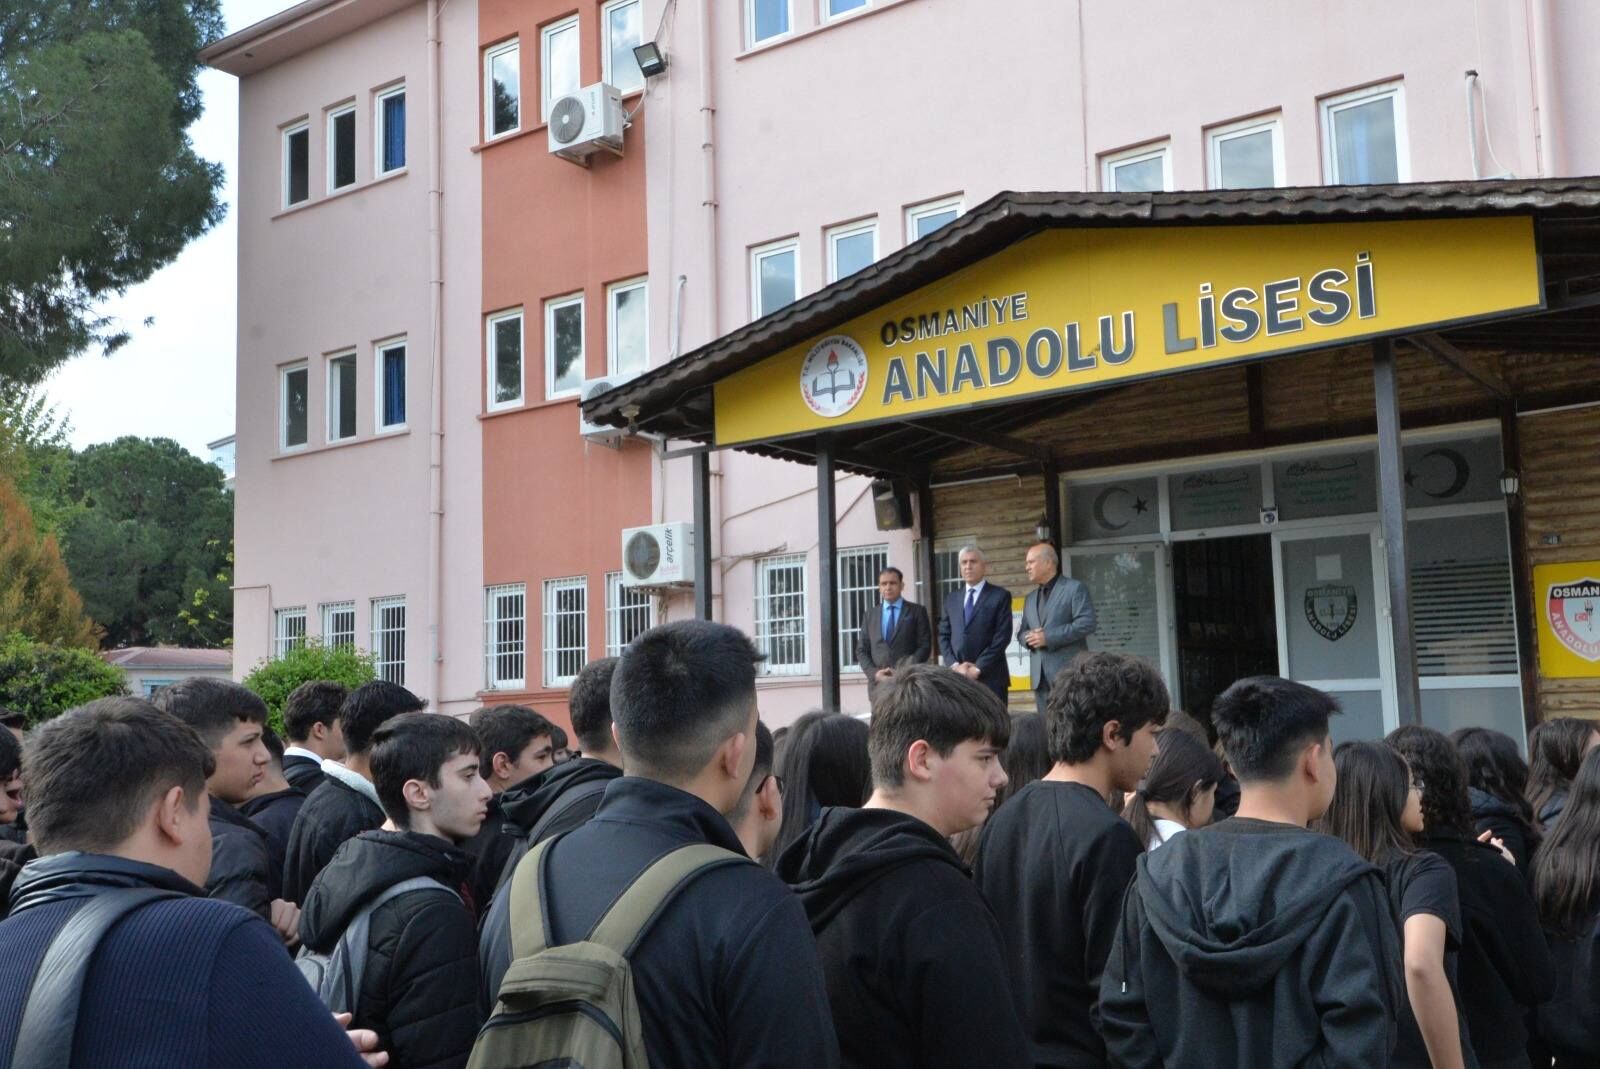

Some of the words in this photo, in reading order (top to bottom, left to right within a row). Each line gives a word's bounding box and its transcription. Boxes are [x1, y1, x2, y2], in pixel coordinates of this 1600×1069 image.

[880, 292, 1028, 348] OSMANİYE
[881, 310, 1135, 405] ANADOLU
[1162, 251, 1376, 355] LİSESİ
[664, 527, 674, 563] arçelik
[1551, 611, 1598, 654] ANADOLU
